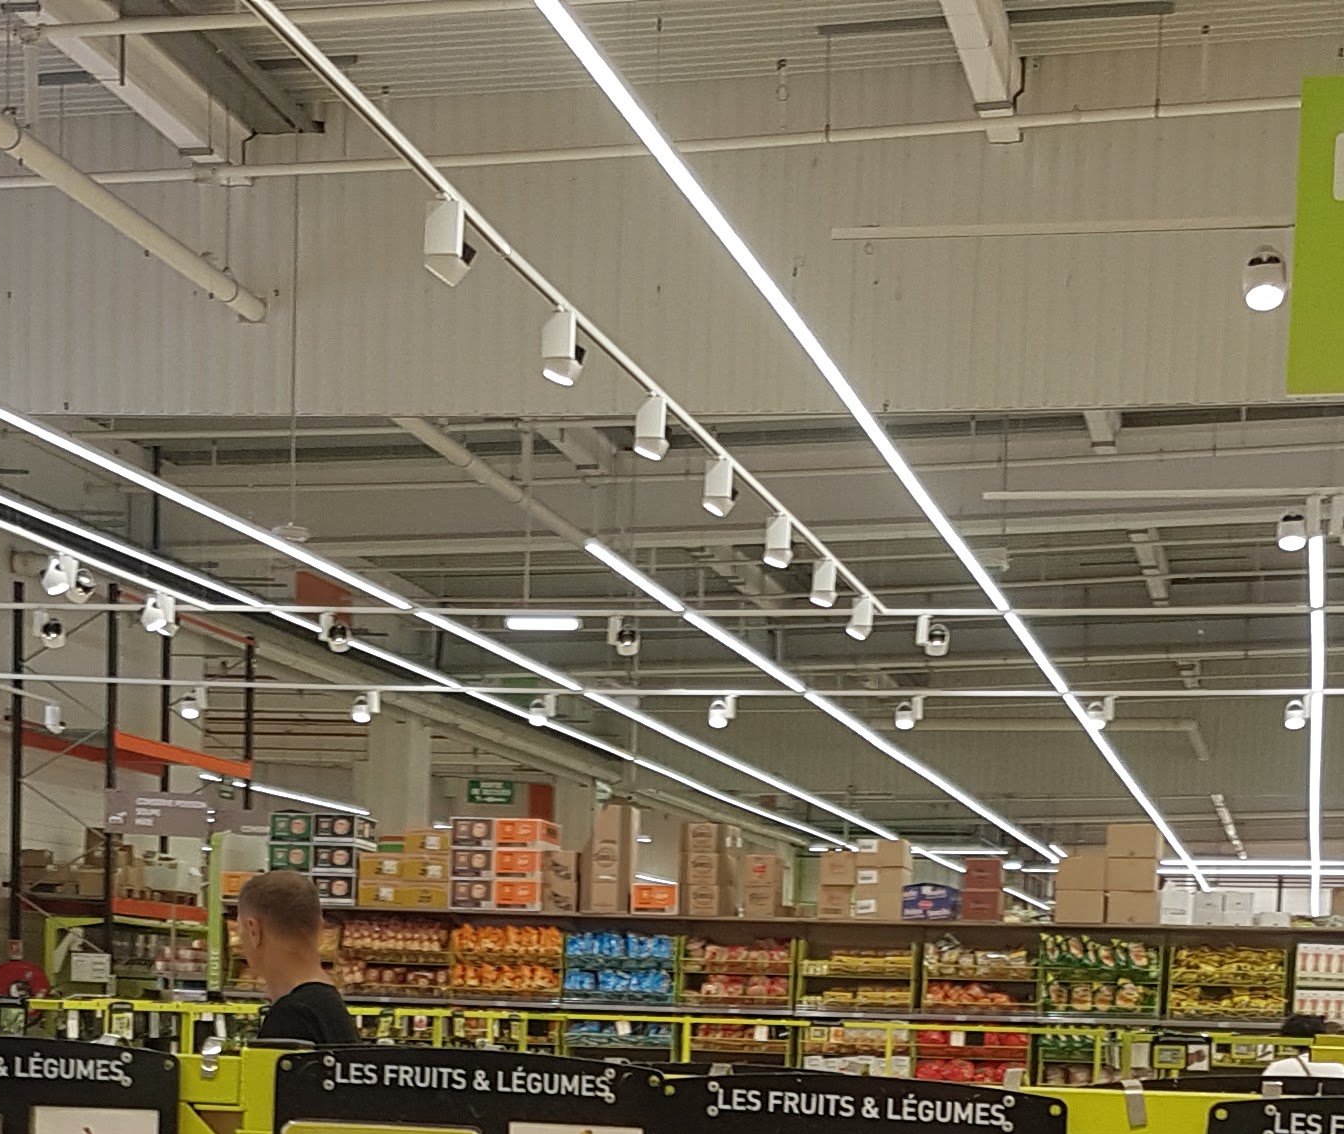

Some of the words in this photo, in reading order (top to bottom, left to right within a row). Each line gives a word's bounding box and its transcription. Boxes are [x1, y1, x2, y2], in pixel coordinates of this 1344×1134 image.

[14, 1052, 124, 1082] LÉGUMES
[335, 1062, 378, 1085] LES
[383, 1065, 467, 1090] FRUITS
[472, 1069, 491, 1092] &
[496, 1066, 611, 1098] LÉGUMES
[717, 1087, 762, 1112] LES
[768, 1091, 855, 1118] FRUITS
[861, 1096, 881, 1119] &
[886, 1093, 1007, 1127] LÉGUMES
